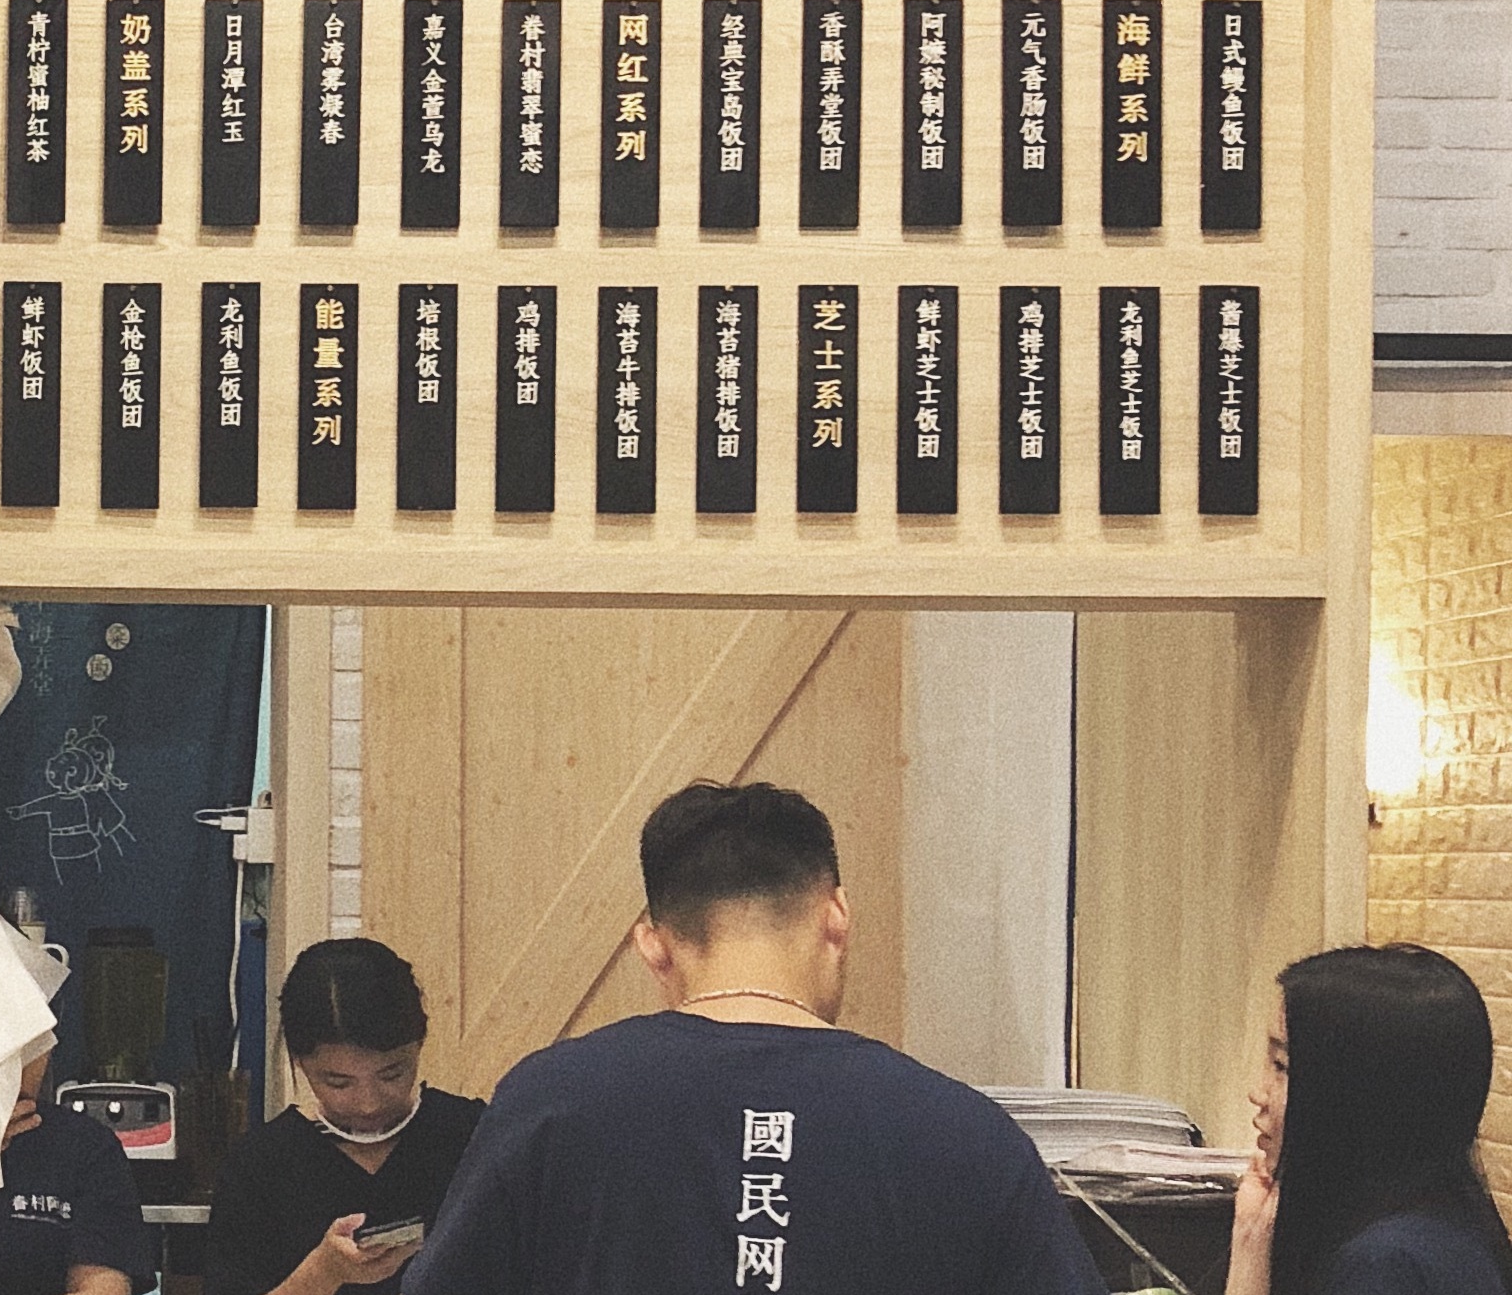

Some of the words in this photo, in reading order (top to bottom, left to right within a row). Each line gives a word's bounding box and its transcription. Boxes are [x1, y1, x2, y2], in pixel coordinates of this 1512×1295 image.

[26, 11, 50, 163] 青柠蜜柚红茶
[119, 13, 152, 155] 奶盖系列
[220, 13, 247, 144] 日月潭红玉
[420, 13, 447, 174] 嘉义金萱乌龙
[519, 14, 546, 174] 眷村翡翠蜜恋
[615, 13, 649, 161] 网红系列
[717, 13, 746, 172] 经典宝岛饭团
[816, 12, 847, 171] 香酥弄堂饭团
[1019, 12, 1047, 170] 元气香肠饭团
[1117, 13, 1151, 162] 海鲜系列
[1219, 14, 1247, 171] 日式鳗鱼饭团
[20, 296, 46, 400] 鲜虾饭团
[119, 298, 146, 428] 金枪鱼饭团
[218, 297, 245, 427] 龙利鱼饭团
[311, 298, 344, 447] 能量系列
[415, 299, 442, 404] 培根饭团
[514, 300, 541, 405] 鸡排饭团
[614, 301, 641, 459] 海苔牛排饭团
[715, 300, 742, 458] 海苔猪排饭团
[812, 300, 846, 448] 芝士系列
[914, 300, 942, 458] 鲜虾芝士饭团
[1018, 301, 1045, 459] 鸡排芝士饭团
[1119, 301, 1144, 460] 龙利鱼芝士饭团
